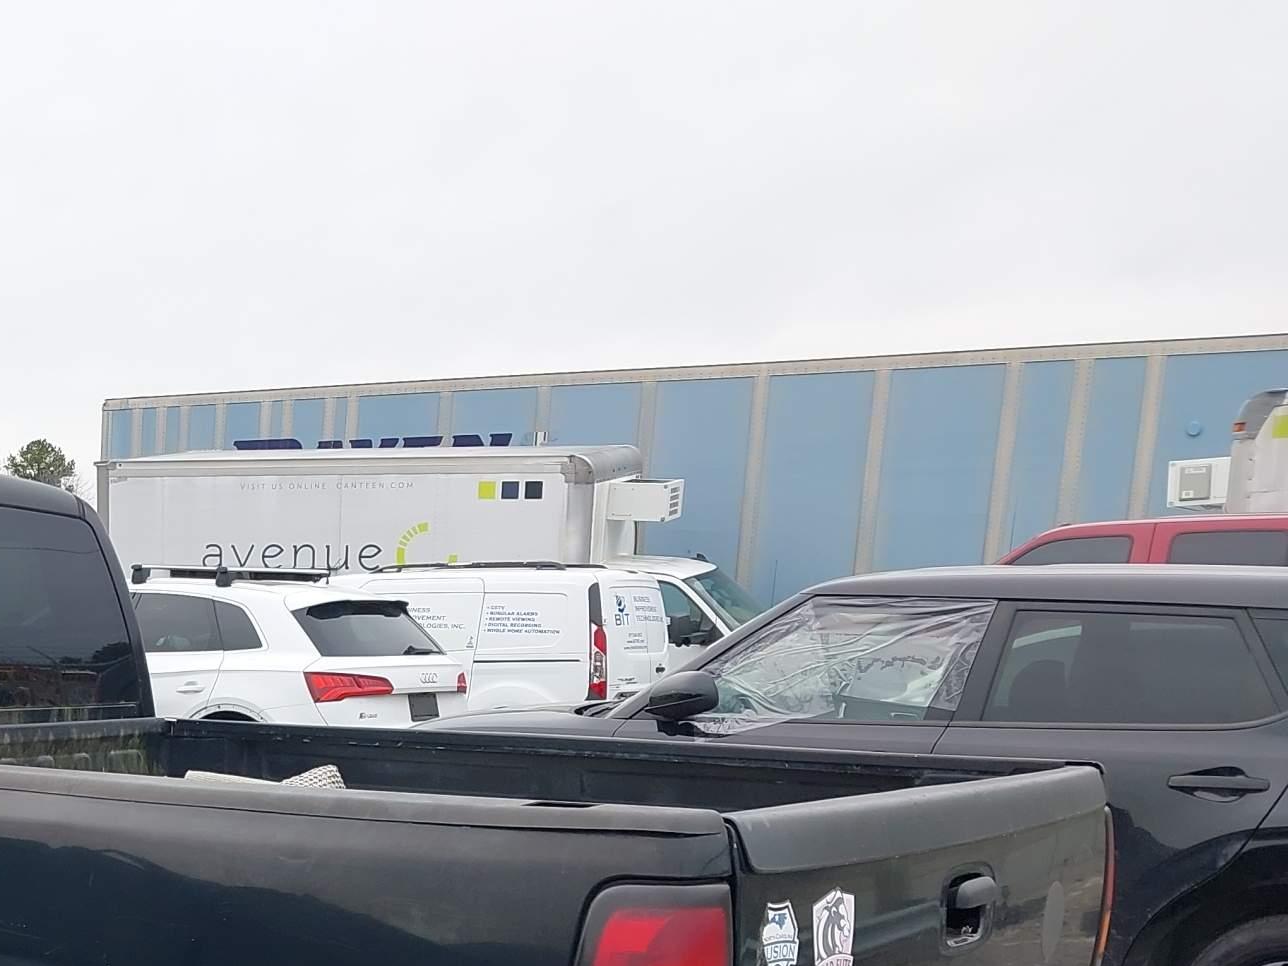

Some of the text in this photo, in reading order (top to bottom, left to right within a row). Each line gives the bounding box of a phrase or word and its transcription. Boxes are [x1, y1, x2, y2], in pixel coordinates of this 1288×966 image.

[239, 482, 266, 491] VISIT
[271, 482, 284, 490] US
[288, 481, 327, 490] ONLINE
[202, 543, 383, 572] avenue
[614, 613, 630, 626] BIT
[766, 943, 796, 961] USION
